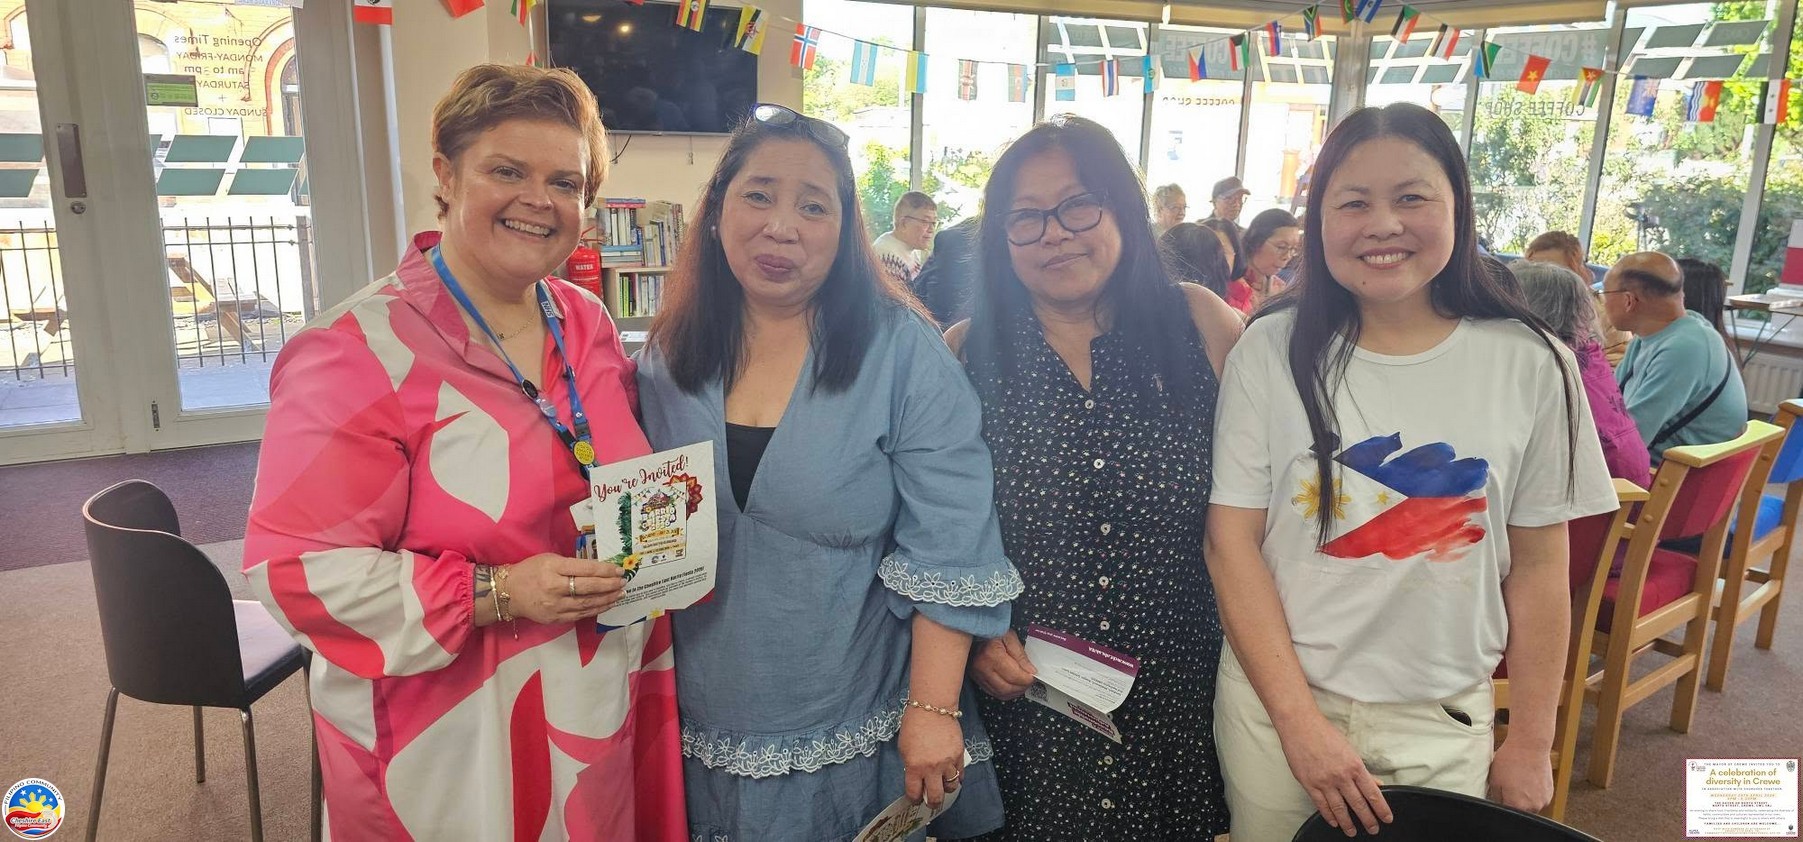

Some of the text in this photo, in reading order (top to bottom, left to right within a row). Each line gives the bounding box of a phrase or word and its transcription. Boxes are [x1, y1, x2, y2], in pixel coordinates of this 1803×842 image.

[542, 302, 554, 316] NHS
[594, 454, 689, 502] You're Invited!
